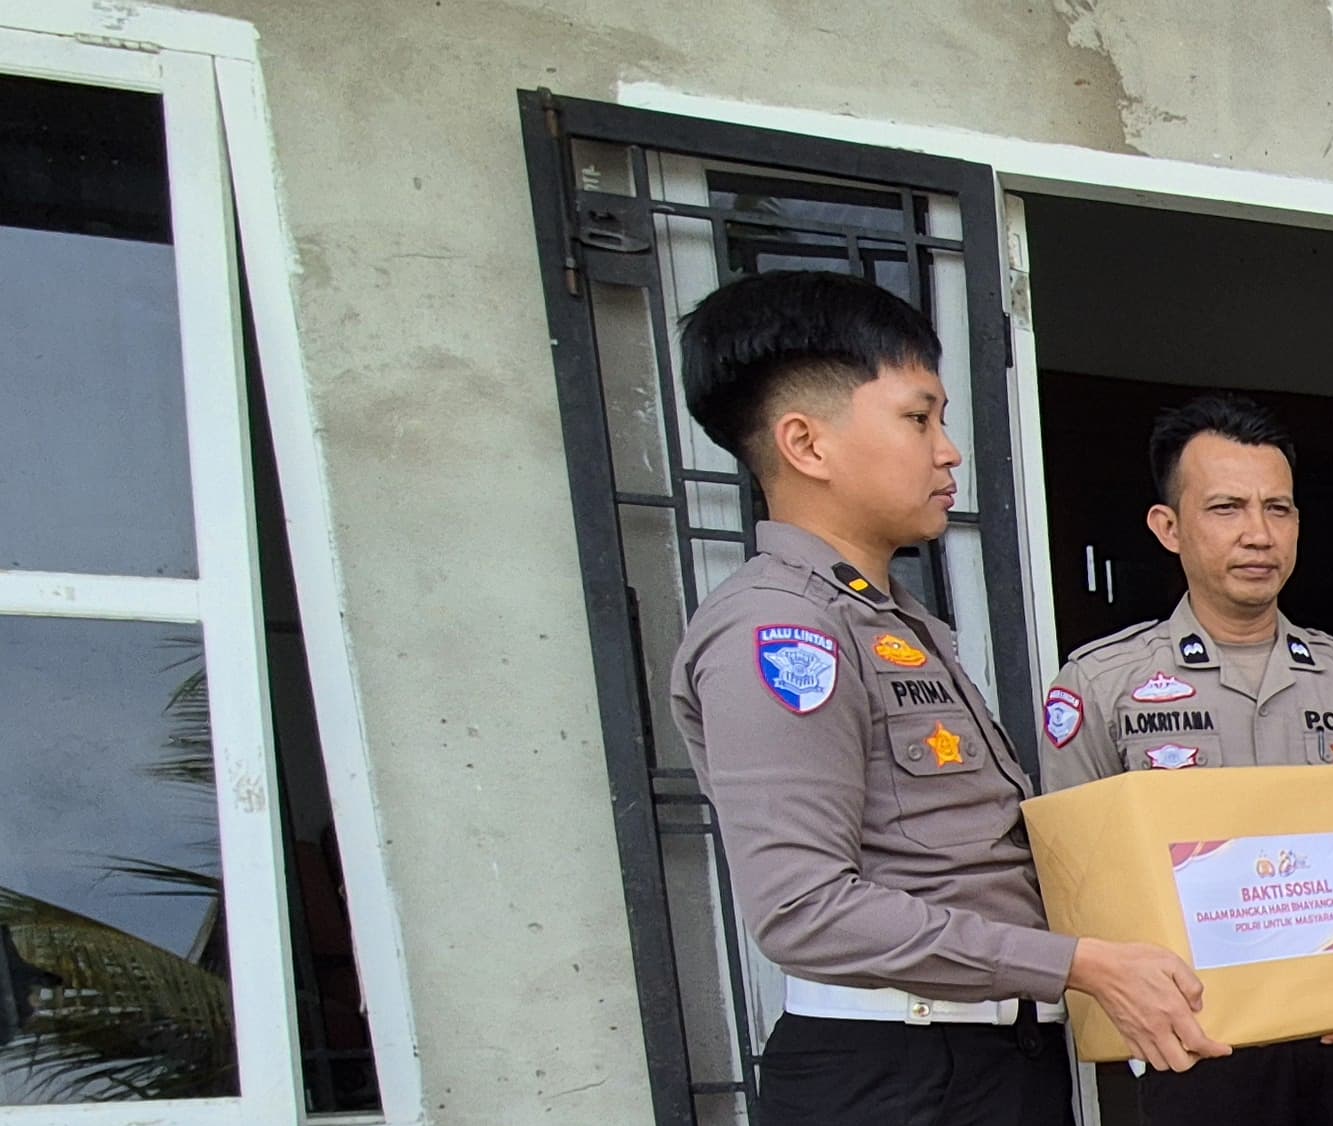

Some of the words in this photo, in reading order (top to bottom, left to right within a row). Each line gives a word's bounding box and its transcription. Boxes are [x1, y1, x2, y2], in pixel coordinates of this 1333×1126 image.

[762, 628, 792, 641] LALU
[794, 629, 833, 651] LINTAS
[891, 680, 954, 707] PRIMA
[1241, 884, 1284, 903] BAKTI
[1285, 879, 1333, 897] SOSIAL
[1196, 910, 1230, 922] DALAM
[1230, 907, 1268, 920] RANGKA
[1269, 904, 1290, 915] HARI
[1235, 920, 1262, 933] POLRI
[1263, 918, 1293, 930] UNTUK
